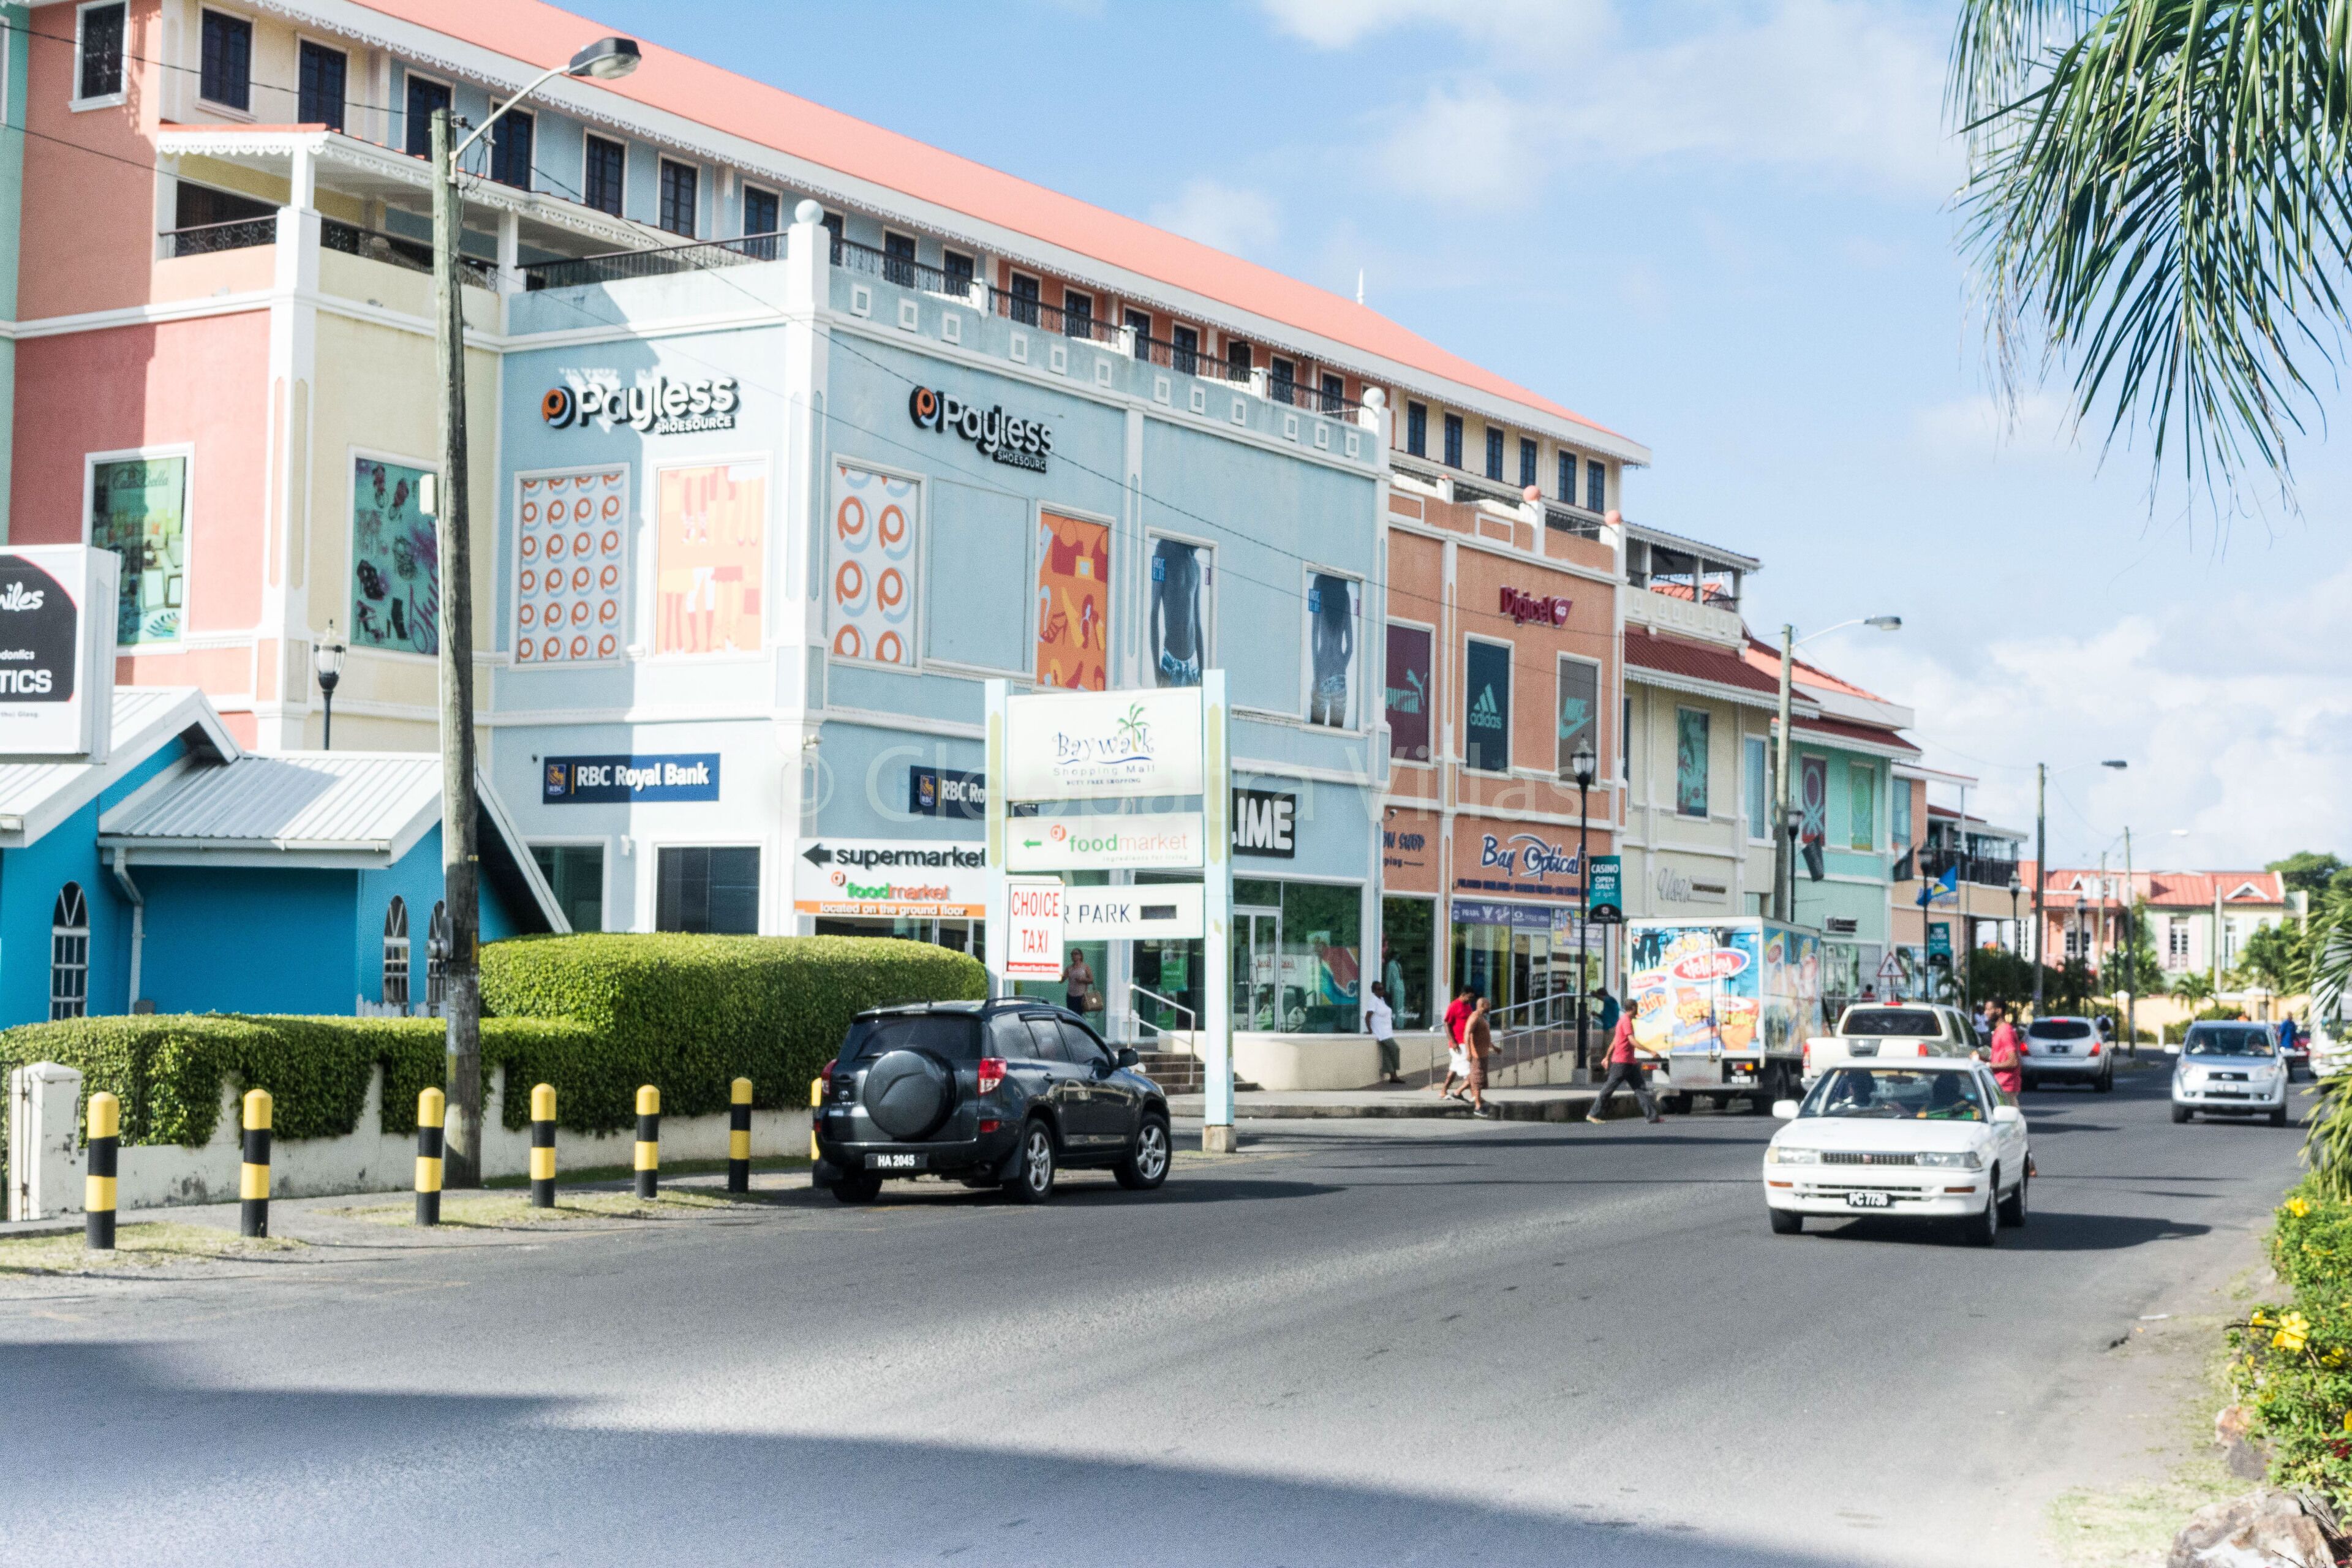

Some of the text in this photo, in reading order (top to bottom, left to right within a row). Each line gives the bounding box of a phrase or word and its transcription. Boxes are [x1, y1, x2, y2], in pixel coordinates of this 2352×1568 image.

[576, 377, 739, 431] Payless
[655, 415, 733, 434] SHOESOURCE
[944, 392, 1054, 456] Payless
[1500, 586, 1549, 625] Digicel
[0, 649, 35, 660] dontics
[1471, 712, 1501, 729] adidas
[577, 761, 710, 792] RBC Royal Bank
[1053, 764, 1155, 777] Shopping Mall
[941, 780, 967, 802] RBC
[1069, 833, 1188, 853] foodmarket
[836, 846, 986, 870] supermarket
[1482, 834, 1581, 881] Bay Optical
[1591, 864, 1619, 874] CASINO
[846, 882, 950, 900] foodmarket
[820, 902, 967, 917] located on the ground floor
[1011, 891, 1060, 918] CHOICE
[1079, 903, 1131, 923] PARK
[1022, 929, 1049, 953] TAXI
[877, 1154, 915, 1167] HA 2045
[1849, 1193, 1864, 1205] PC
